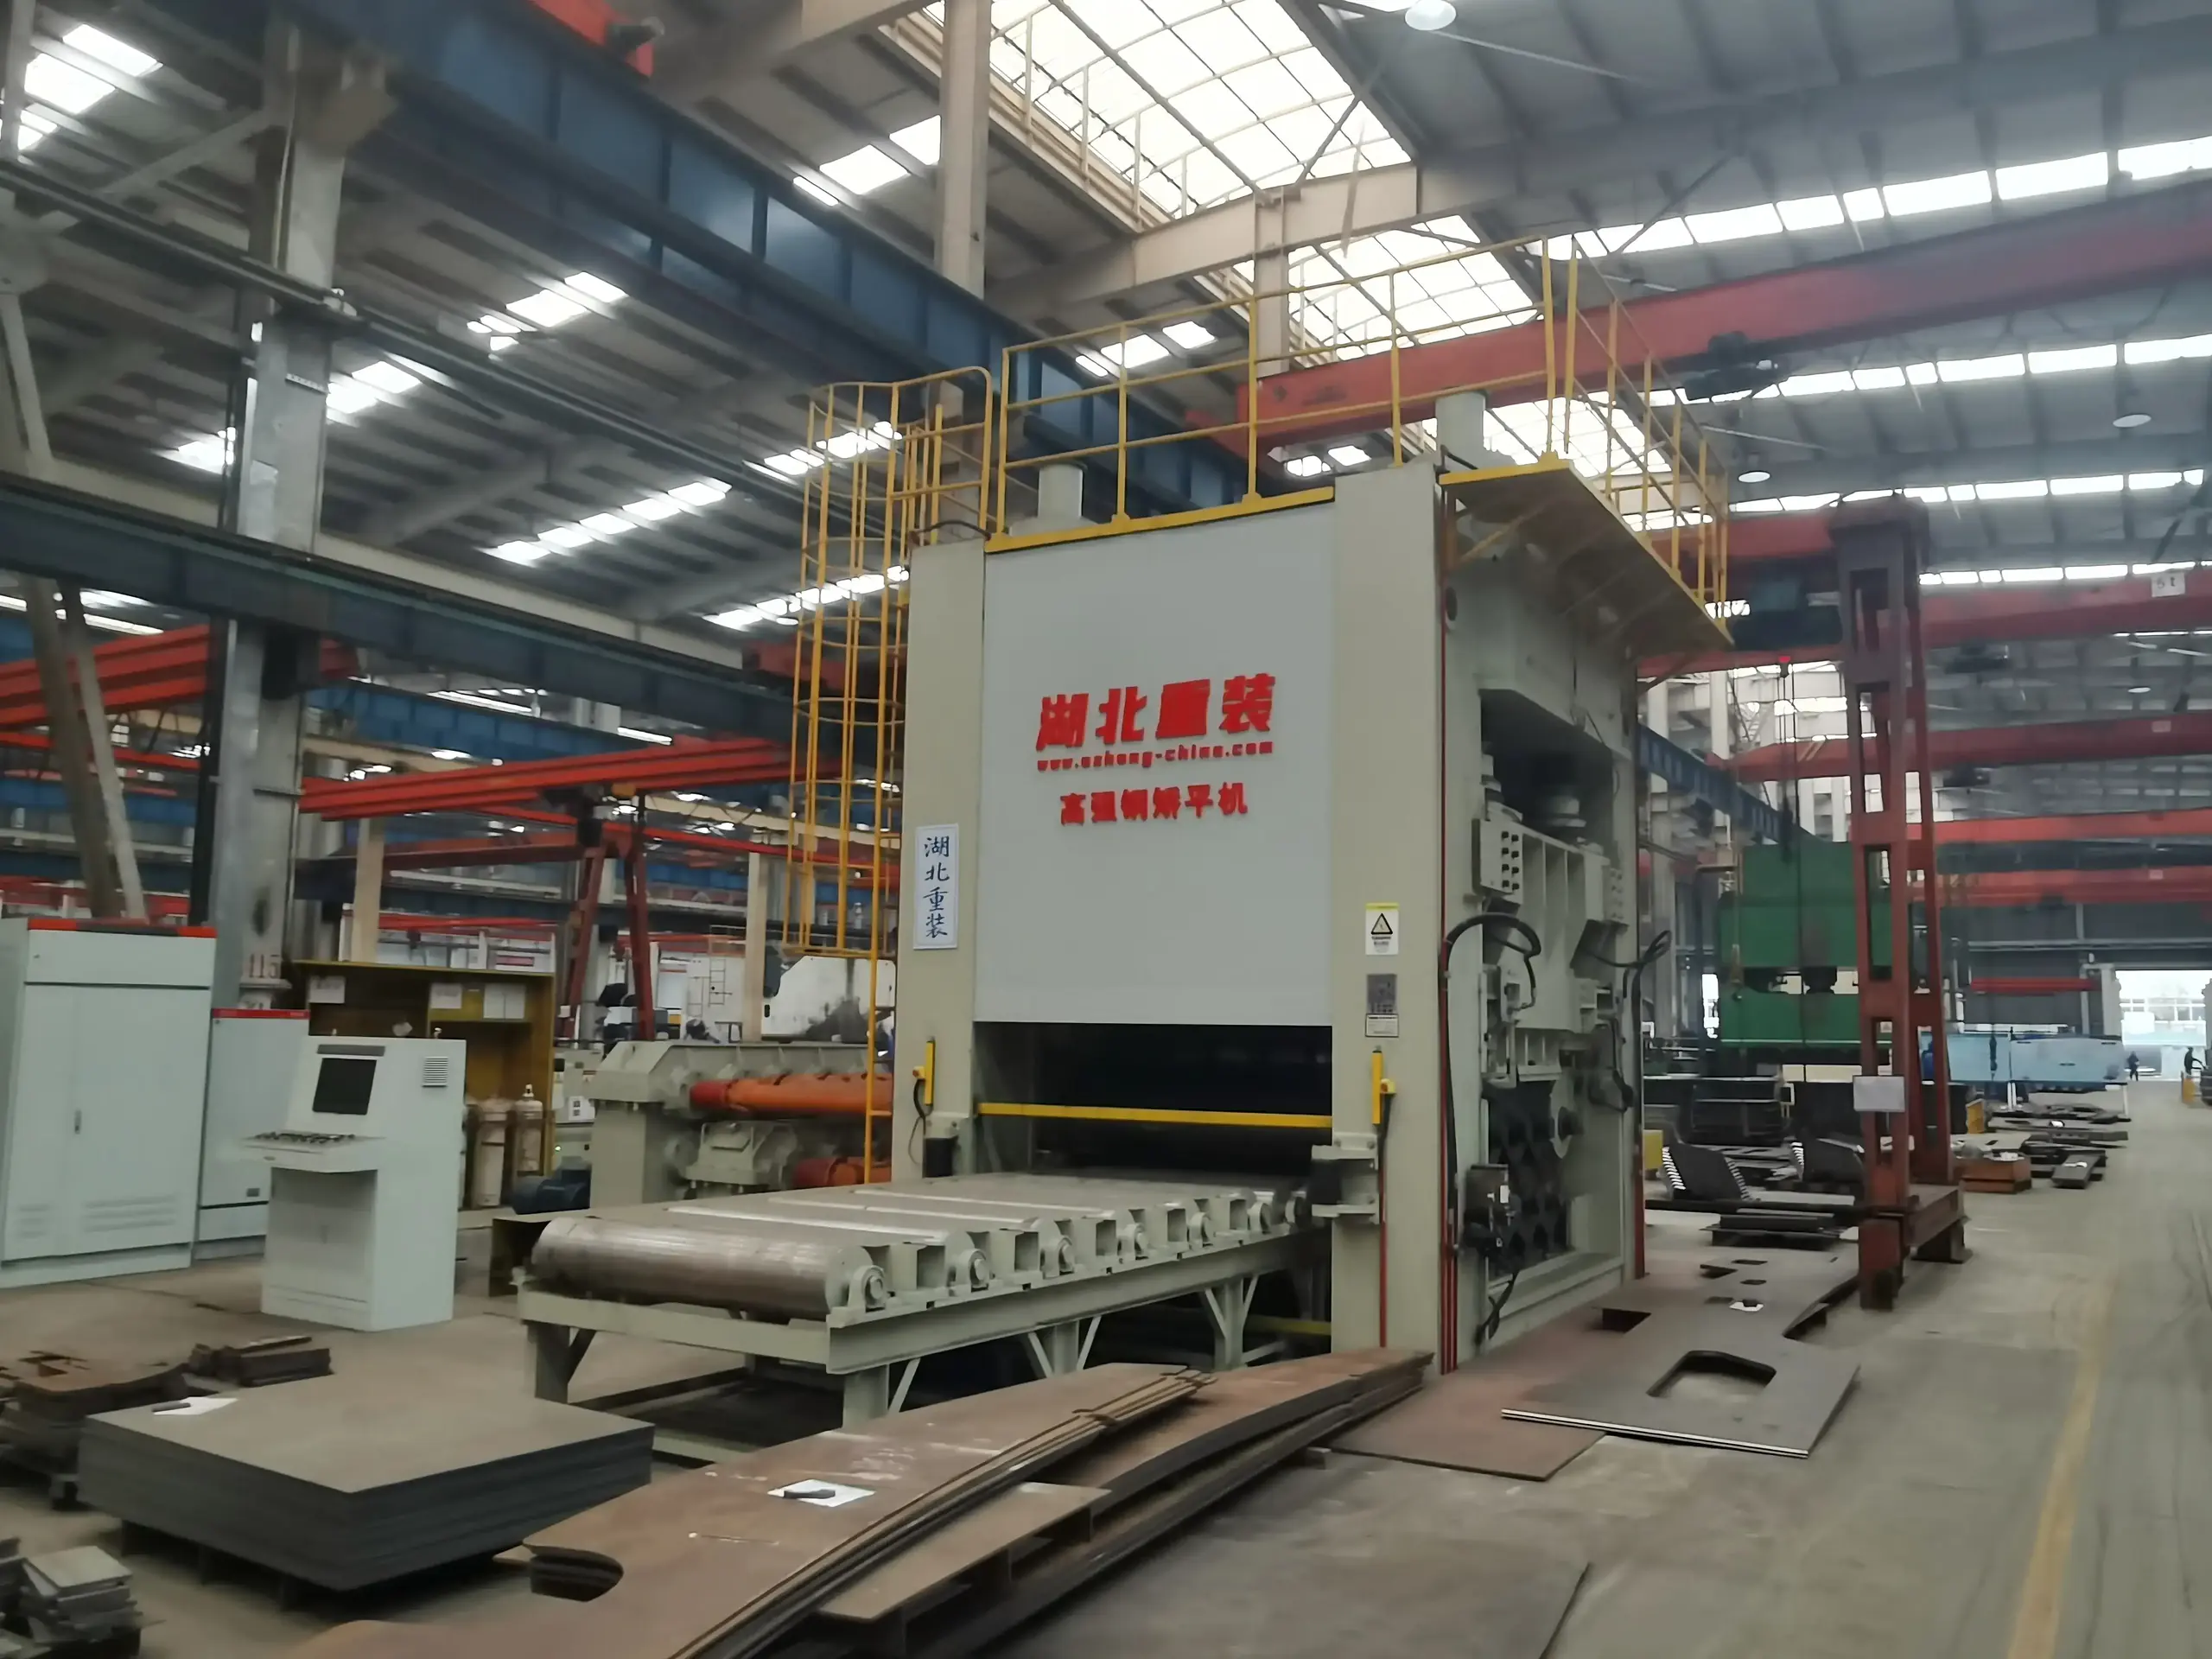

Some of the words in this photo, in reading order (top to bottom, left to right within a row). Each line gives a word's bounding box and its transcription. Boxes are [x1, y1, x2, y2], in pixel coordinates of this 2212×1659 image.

[924, 836, 950, 938] 湖北重装
[249, 954, 281, 979] 115
